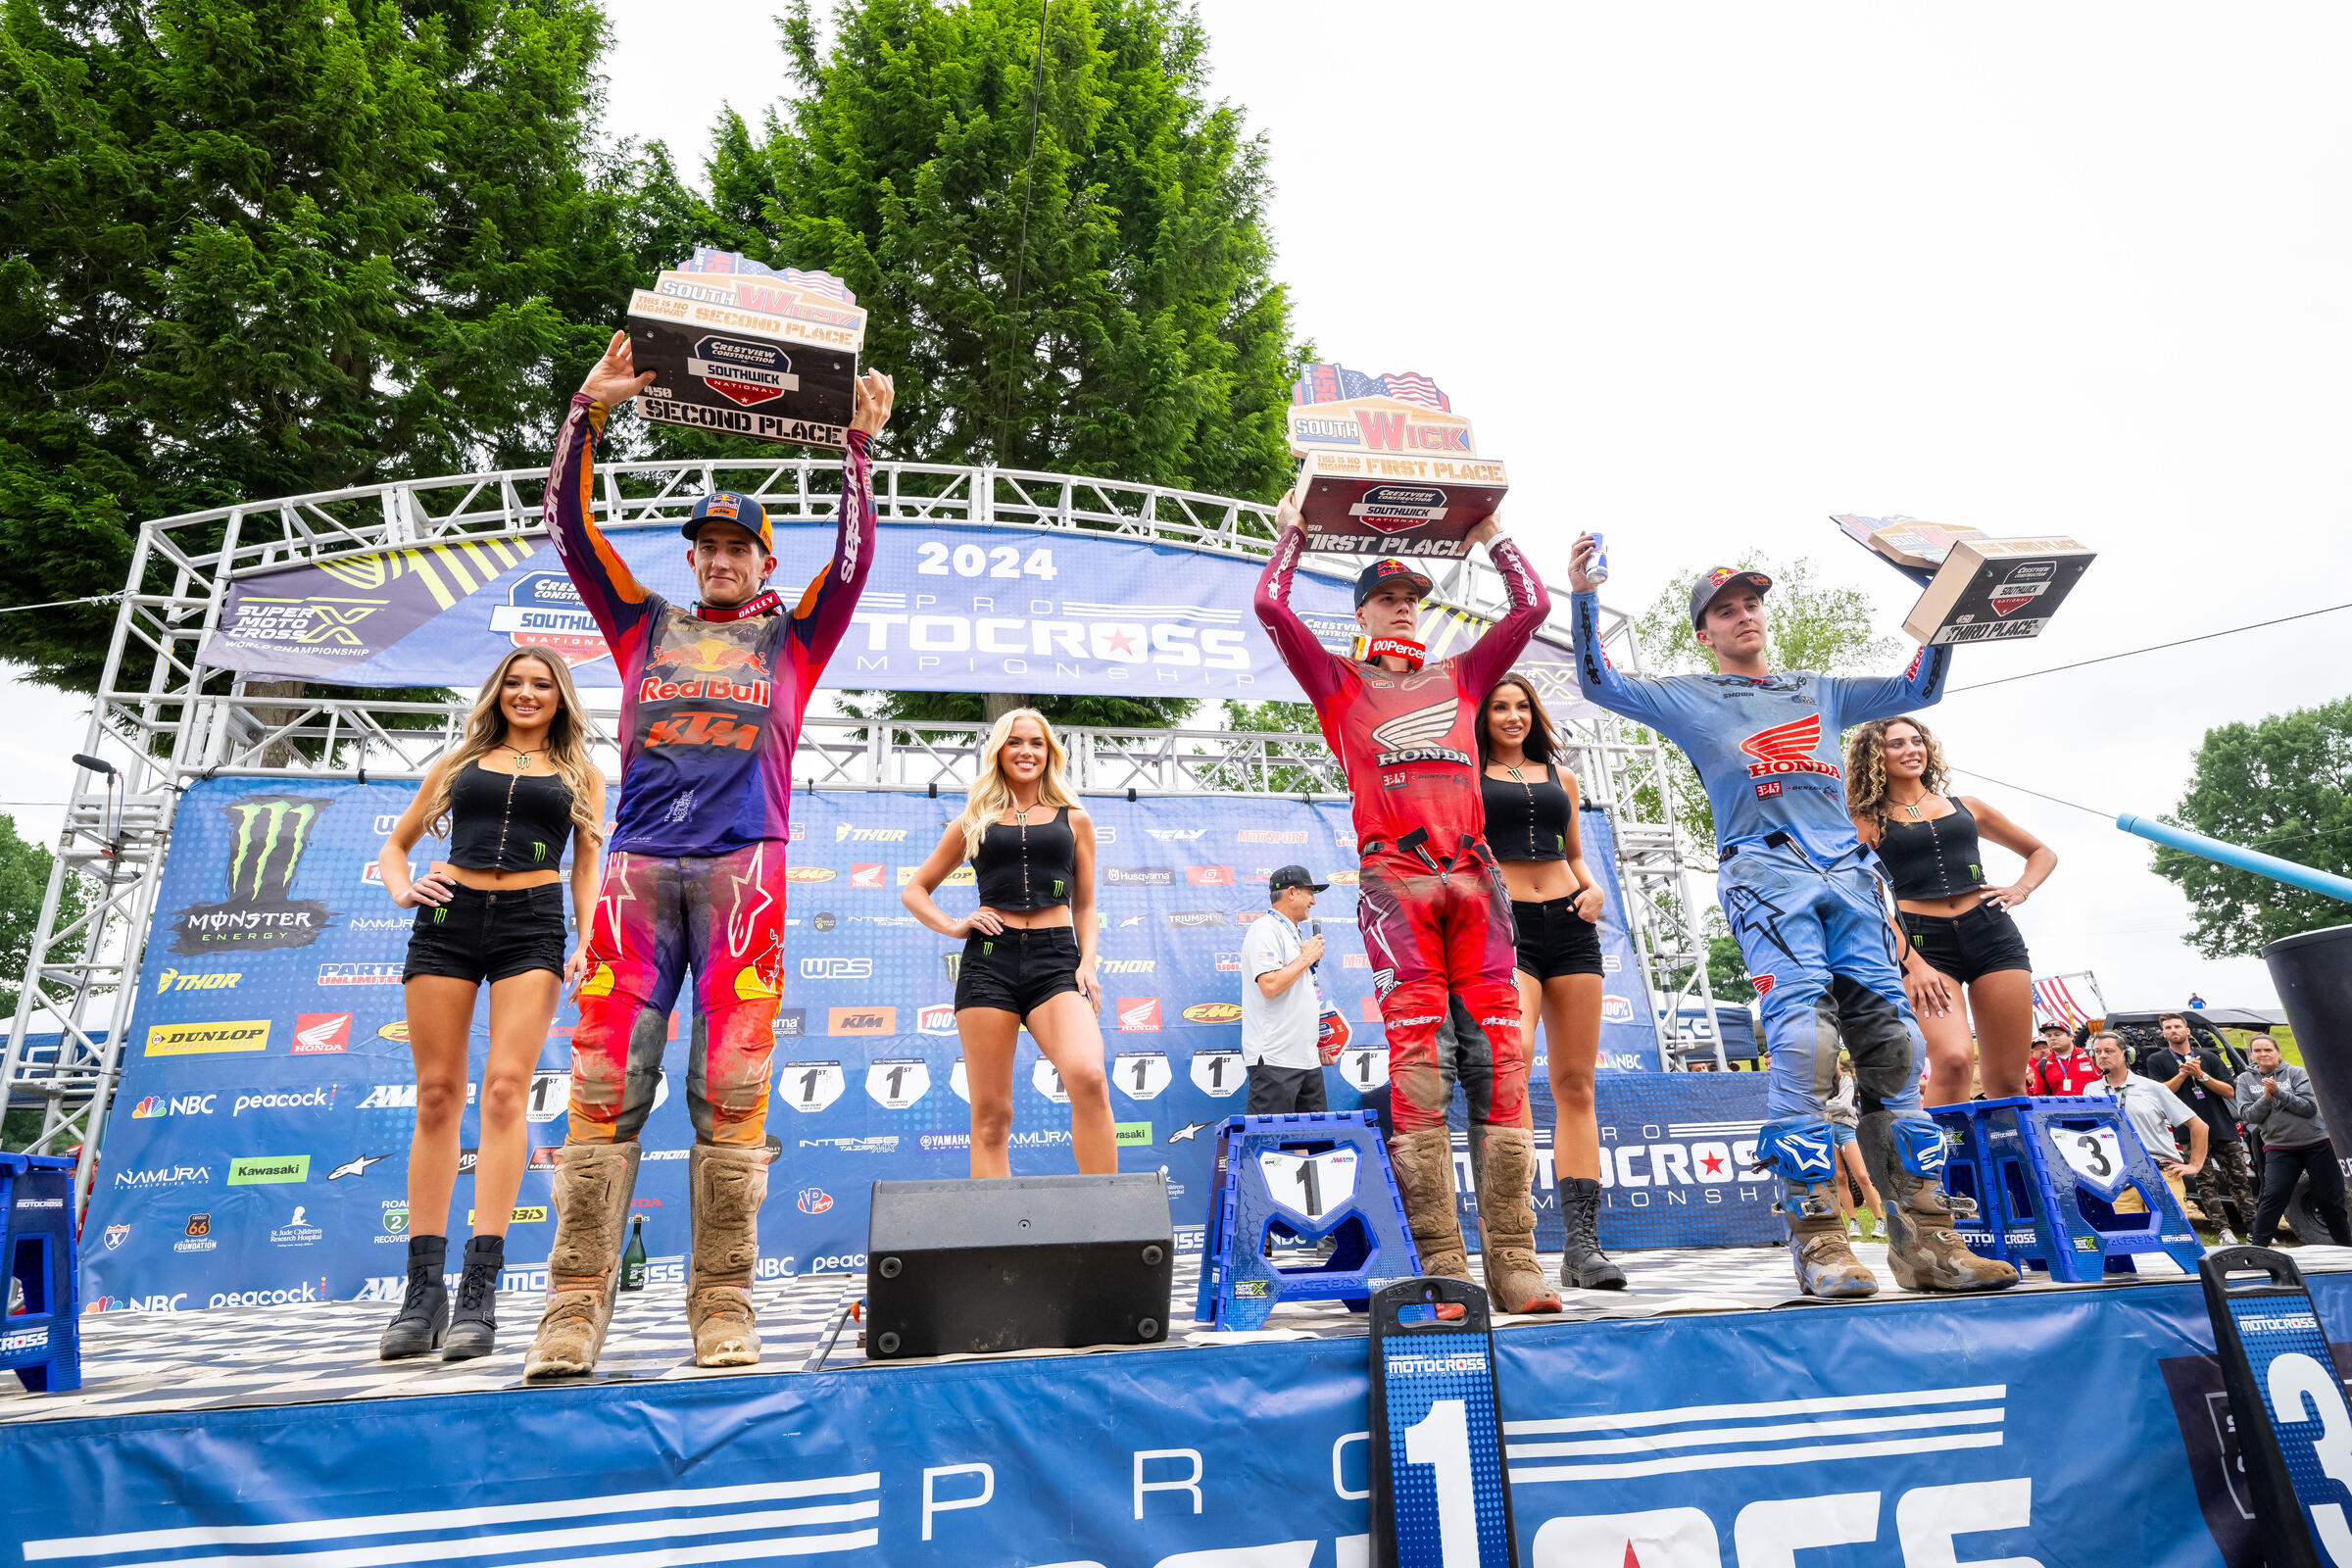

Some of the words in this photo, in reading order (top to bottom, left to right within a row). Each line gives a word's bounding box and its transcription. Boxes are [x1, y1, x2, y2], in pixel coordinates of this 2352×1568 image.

[634, 302, 687, 318] HIGHWAY
[637, 295, 660, 306] THIS
[662, 299, 671, 308] IS
[673, 302, 689, 311] NO
[695, 307, 781, 334] SECOND
[785, 318, 854, 346] PLACE
[710, 341, 776, 359] CRESTVIEW
[711, 349, 776, 365] CONSTRUCTION
[708, 364, 780, 385] SOUTHWICK
[713, 379, 776, 395] NATIONAL
[645, 398, 752, 432] SECOND
[759, 416, 843, 446] PLACE
[1317, 454, 1335, 464] THIS
[1348, 457, 1361, 466] NO
[1317, 463, 1361, 473] HIGHWAY
[1366, 458, 1428, 478] FIRST
[1434, 463, 1504, 482] PLACE
[1380, 489, 1436, 500] CRESTVIEW
[1366, 506, 1430, 516] SOUTHWICK
[917, 541, 1058, 581] 2024
[2017, 564, 2051, 574] CRESTVIEW
[1378, 567, 1395, 577] Red
[2000, 584, 2039, 596] SOUTHWICK
[235, 605, 314, 619] SUPER
[738, 595, 774, 618] OAKLEY
[916, 593, 1054, 615] PRO
[236, 616, 309, 629] MOTO
[519, 612, 600, 631] SOUTHW
[1956, 614, 1976, 623] 450
[227, 627, 308, 641] CROSS
[1945, 623, 1989, 642] THIRD
[1988, 619, 2040, 637] PLACE
[224, 640, 262, 652] WORLD
[263, 643, 370, 658] CHAMPIONSHIP
[526, 635, 607, 647] NATIONA
[849, 612, 1251, 670] TOCROSS
[857, 655, 1255, 687] MPIONSHIP
[1904, 646, 1925, 682] HON
[638, 676, 705, 705] Red
[706, 675, 771, 708] Bull
[644, 711, 760, 751] KTM
[1377, 749, 1473, 767] HONDA
[1747, 760, 1842, 781] HONDA
[852, 828, 907, 842] THOR
[1120, 871, 1170, 881] Husqvarna
[350, 916, 415, 929] NAMUR
[1168, 914, 1213, 923] TRIUMPH
[202, 932, 288, 942] ENERGY
[801, 957, 873, 979] WPS
[1102, 959, 1154, 973] THOR
[175, 971, 243, 991] THOR
[318, 976, 405, 986] UNLIMITE
[1601, 1002, 1628, 1016] 100%
[840, 1013, 885, 1029] KTM
[1387, 1014, 1443, 1030] alpinestars
[1481, 1015, 1521, 1028] alpine
[167, 1029, 265, 1044] DUNLOP
[294, 1044, 344, 1053] HONDA
[1616, 1054, 1642, 1070] NBC
[232, 1087, 327, 1117] peacock
[355, 1084, 417, 1109] AM
[169, 1094, 218, 1116] NBC
[931, 1135, 971, 1146] YAMAHA
[1007, 1128, 1073, 1145] AMURA
[1116, 1129, 1146, 1140] asaki
[1601, 1124, 1660, 1141] RO
[800, 1136, 900, 1148] INTENSE
[640, 1150, 690, 1161] LANDM
[2077, 1135, 2112, 1177] 3
[115, 1164, 210, 1185] NAMURA
[237, 1164, 300, 1177] Kawasaki
[1296, 1159, 1323, 1216] 1
[799, 1188, 823, 1214] VP
[188, 1221, 208, 1235] 66
[390, 1216, 402, 1230] 2
[173, 1241, 218, 1251] FOUNDATION
[373, 1235, 411, 1245] RECOVER
[812, 1252, 868, 1275] peac
[129, 1293, 188, 1312] NBC
[209, 1280, 317, 1310] peacock
[2239, 1317, 2318, 1332] MOTOCROSS
[1388, 1358, 1487, 1373] MOTOCROSS
[1389, 1370, 1488, 1379] CHAMPIONSHIP
[1403, 1398, 1482, 1568] 1
